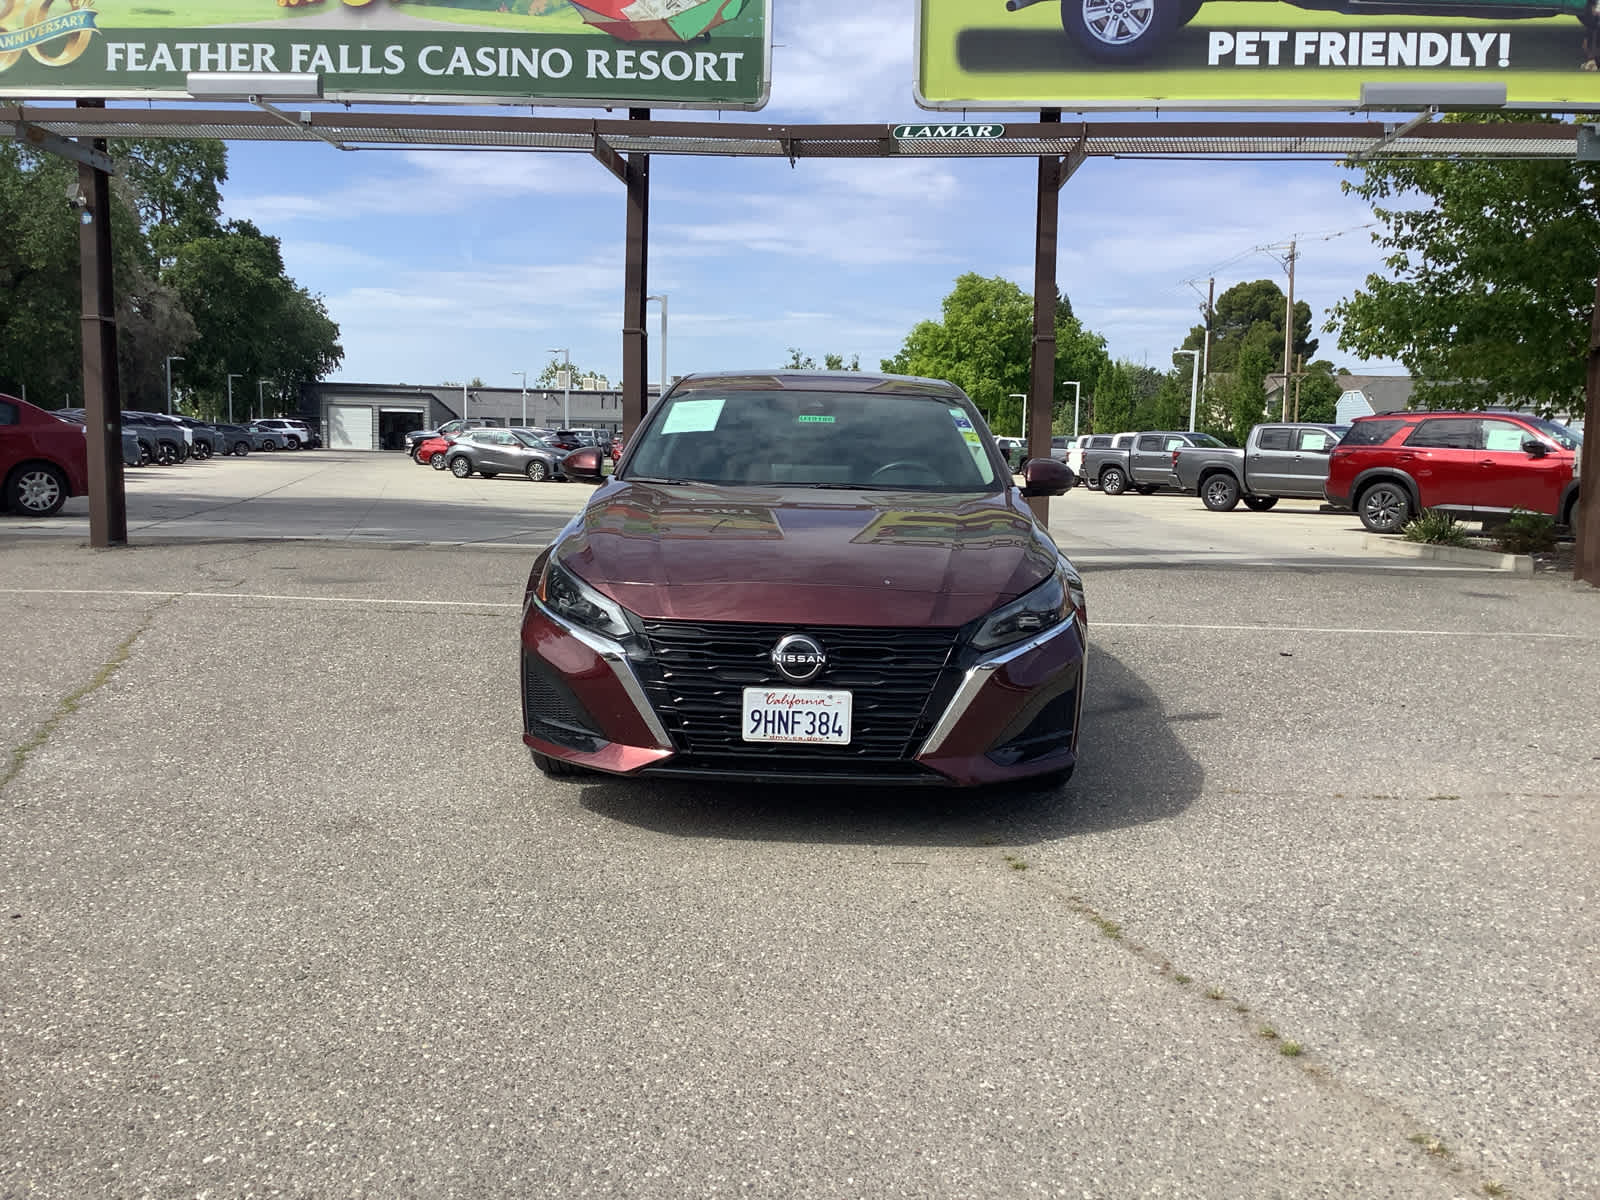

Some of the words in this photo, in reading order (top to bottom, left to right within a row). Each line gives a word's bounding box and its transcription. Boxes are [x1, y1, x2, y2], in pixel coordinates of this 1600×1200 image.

[1208, 31, 1288, 66] PET
[1294, 31, 1511, 67] FRIENDLY!
[105, 43, 280, 73] FEATHER
[290, 44, 406, 75] FALLS
[418, 45, 573, 79] CASINO
[586, 50, 744, 82] RESORT
[902, 126, 993, 137] LAMAR
[772, 653, 826, 663] NISSAN
[766, 692, 832, 709] California
[750, 709, 844, 737] 9HNF384
